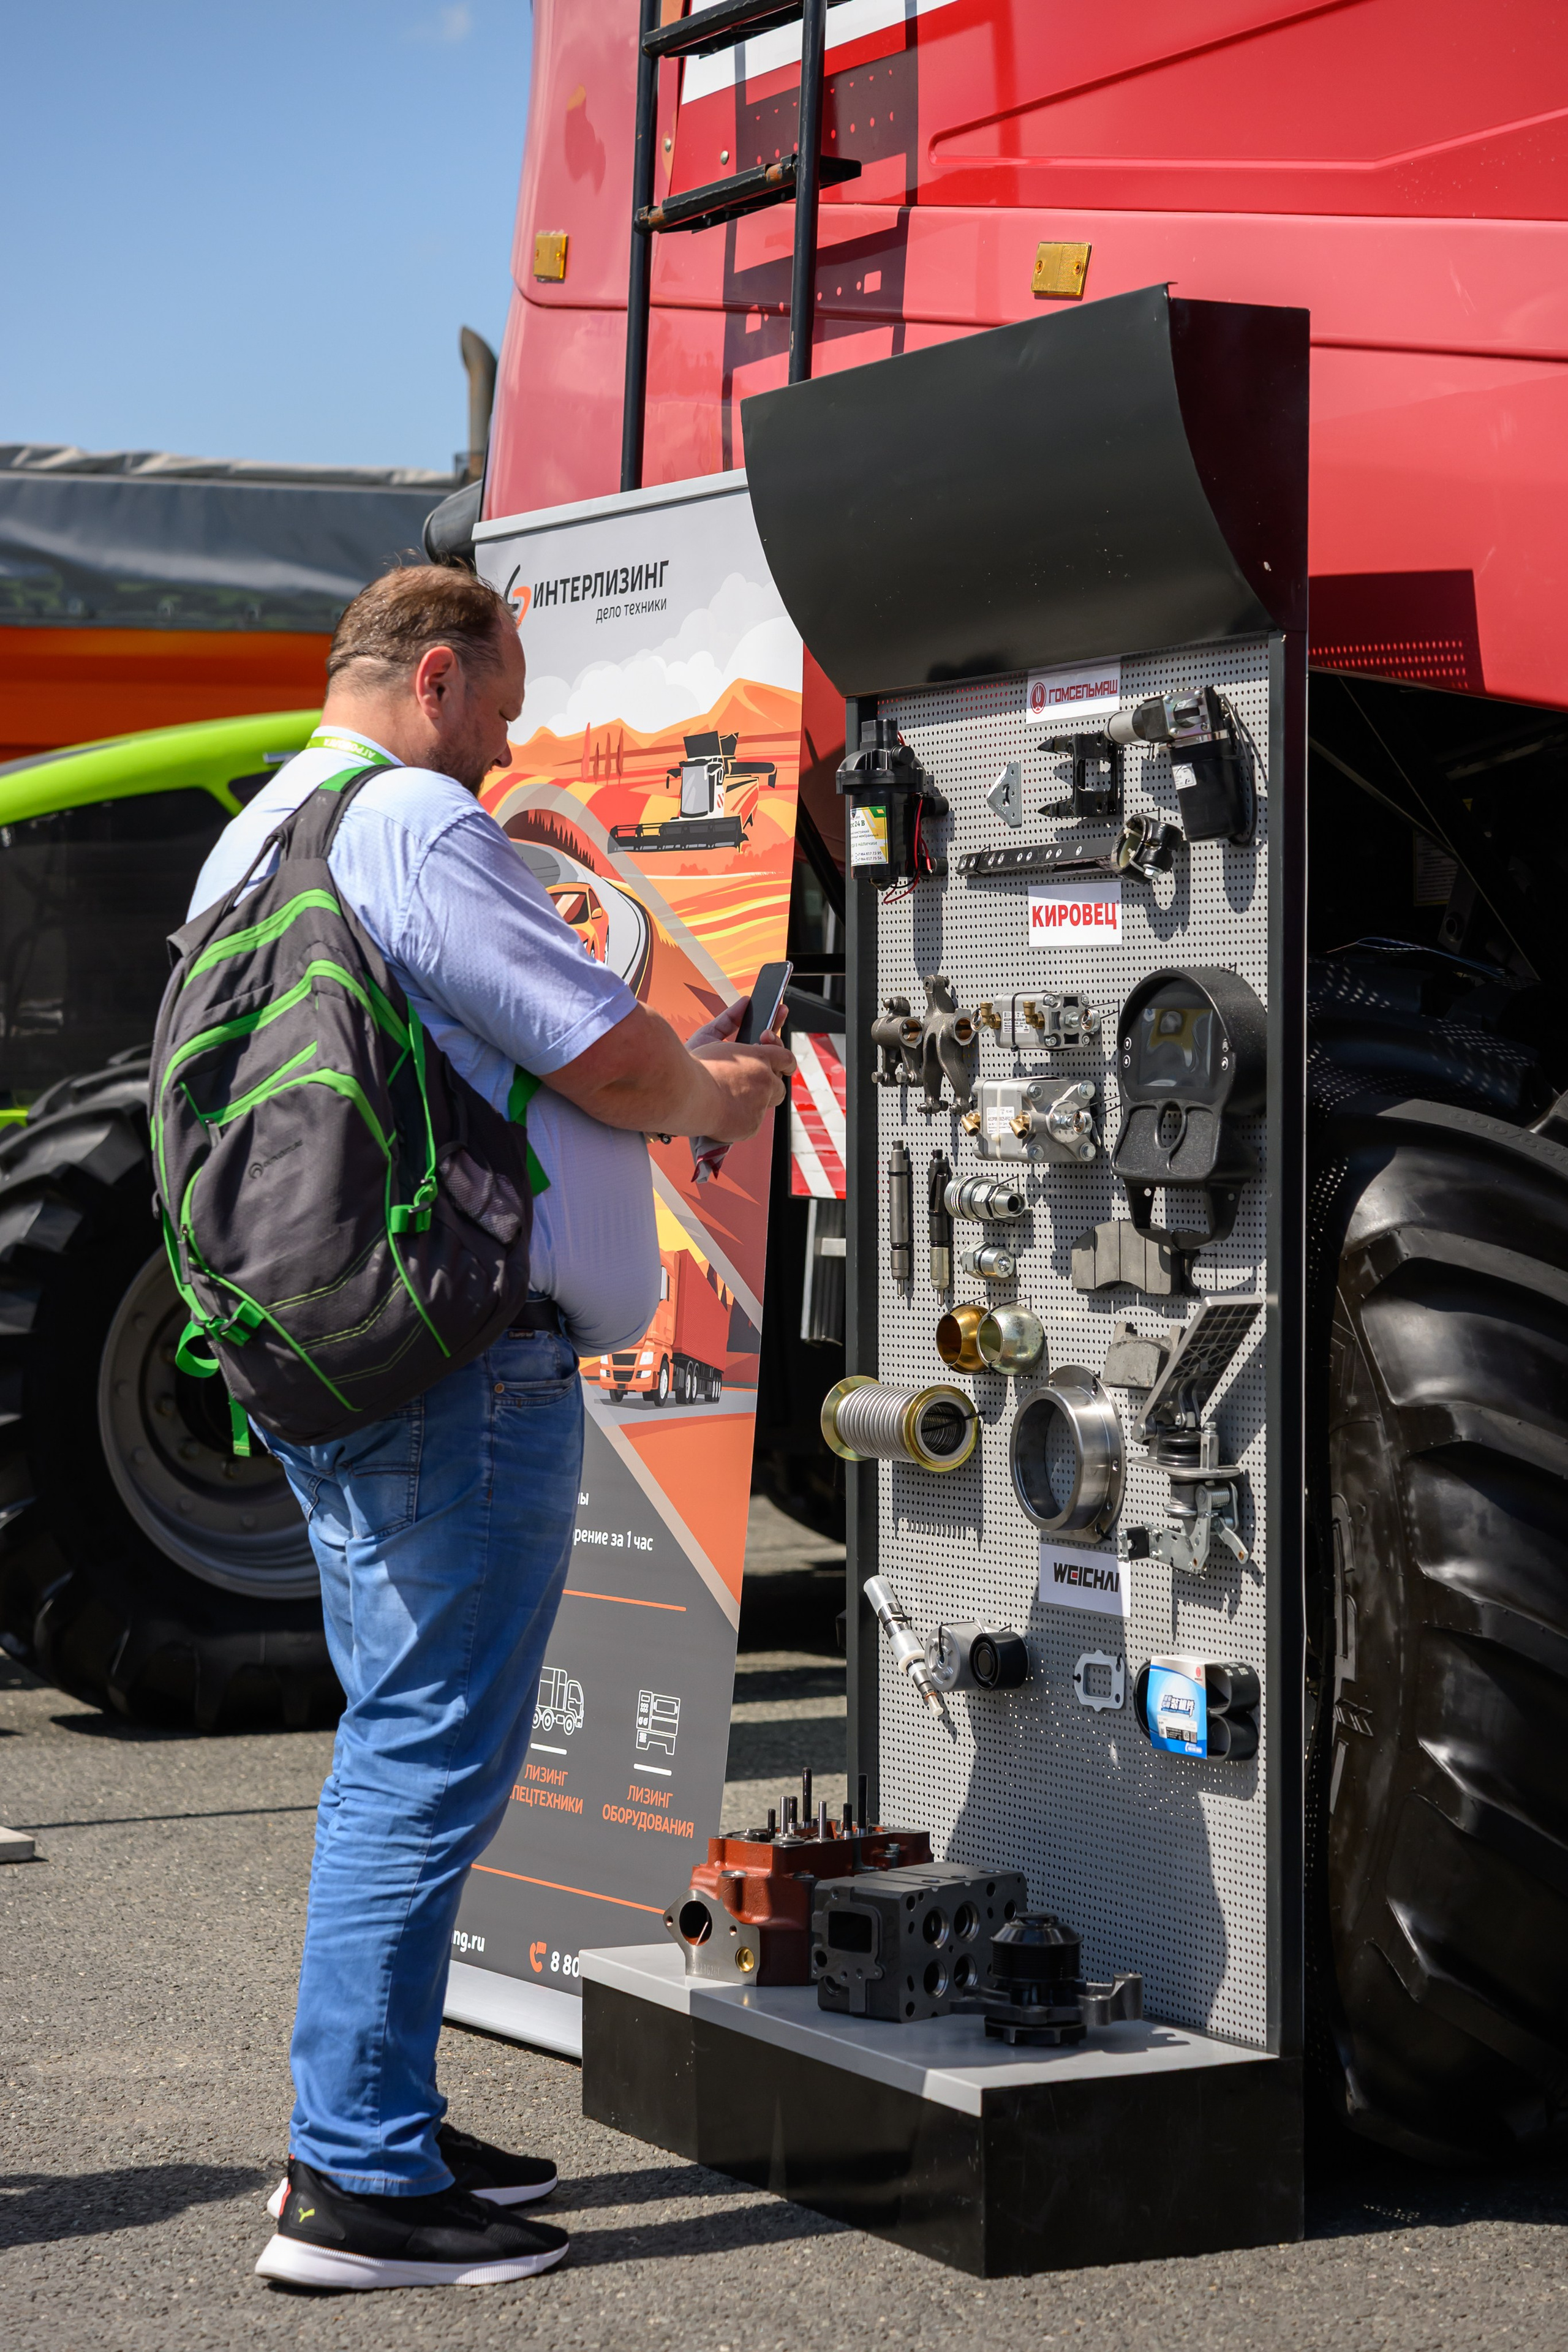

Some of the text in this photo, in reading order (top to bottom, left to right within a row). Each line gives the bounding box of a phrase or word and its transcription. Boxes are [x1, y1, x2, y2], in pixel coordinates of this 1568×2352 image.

[533, 560, 669, 608] ИНТЕРЛИЗИНГ
[595, 598, 667, 624] дело техники
[1049, 679, 1118, 703] ГОМСЕЛЬМАШ
[1032, 903, 1117, 930] КИРОВЕЦ
[573, 1528, 654, 1551] рение за 1 час
[1054, 1562, 1120, 1593] WEICHAI
[524, 1764, 568, 1787] ЛИЗИНГ
[509, 1784, 583, 1814] ПЕЦТЕХНИКИ
[627, 1785, 673, 1808] ЛИЗИНГ
[602, 1804, 694, 1839] ОБОРУДОВАНИЯ
[452, 1929, 485, 1953] ng.ru
[551, 1951, 560, 1972] 8
